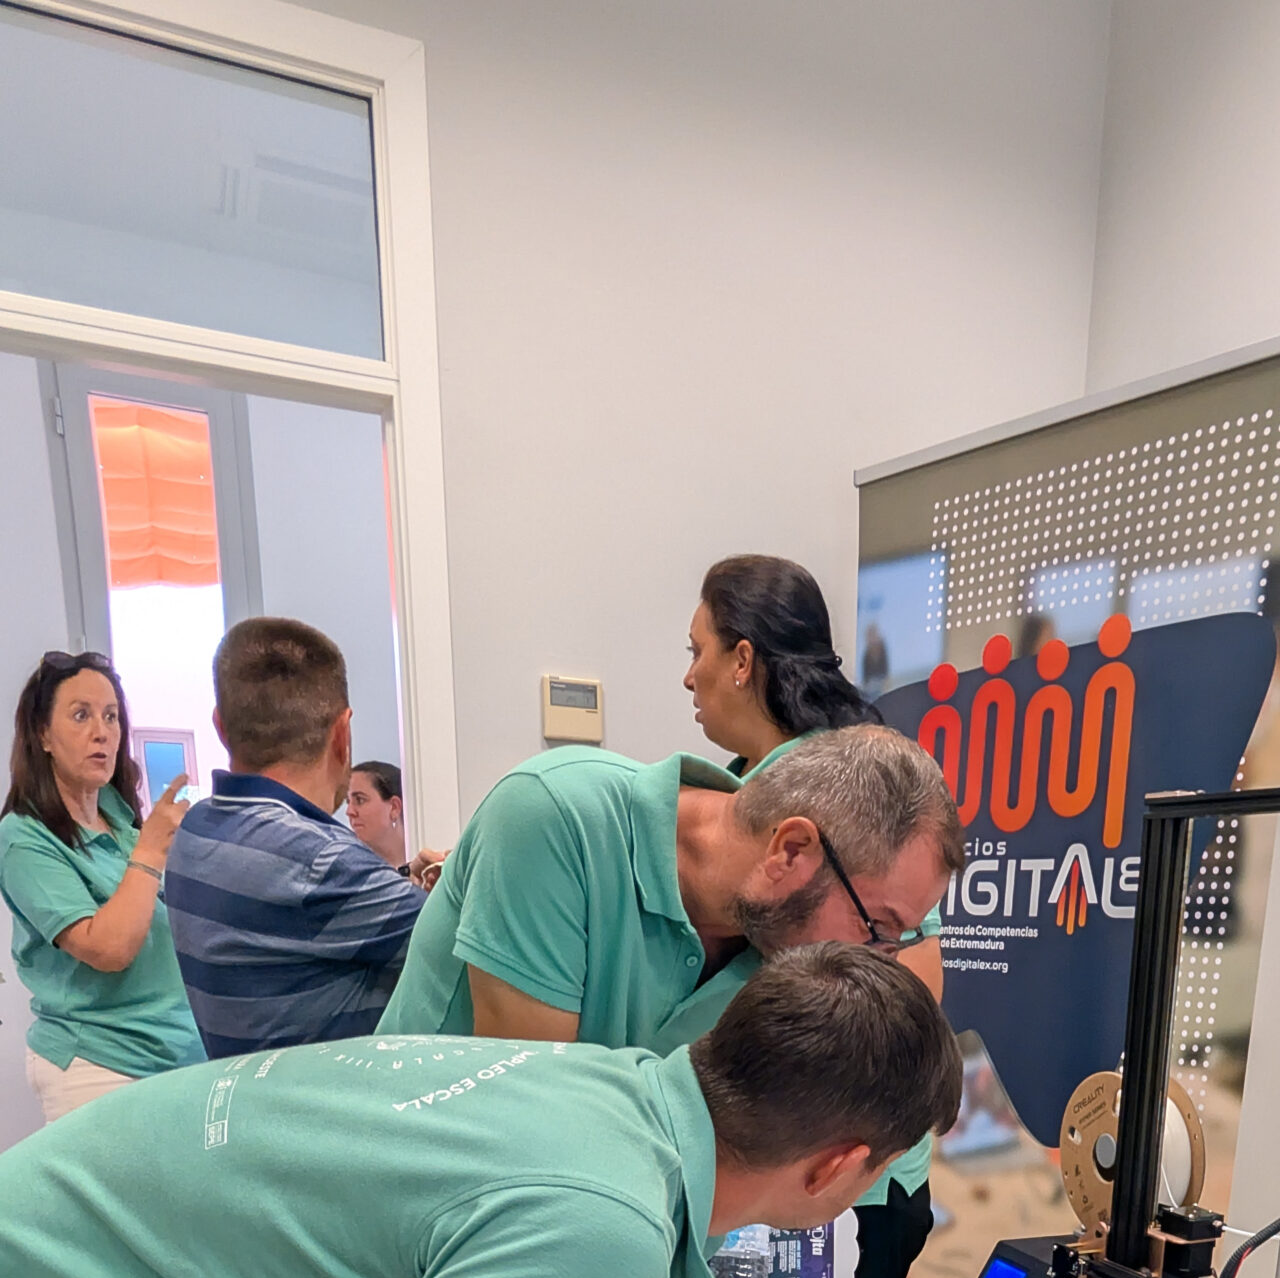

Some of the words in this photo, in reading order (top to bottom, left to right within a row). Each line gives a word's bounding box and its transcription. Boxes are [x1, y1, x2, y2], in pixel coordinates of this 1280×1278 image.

[964, 837, 1007, 856] cios
[946, 843, 1141, 919] IGITALE
[940, 925, 964, 936] entros
[964, 926, 975, 936] de
[976, 925, 1039, 938] Competencias
[940, 940, 950, 948] de
[950, 940, 1005, 950] Extremadura
[942, 957, 1009, 973] iosdigitalex.org
[477, 1049, 538, 1080] MPLEO
[392, 1077, 477, 1112] ESCALA
[1073, 1085, 1105, 1114] CREALITY
